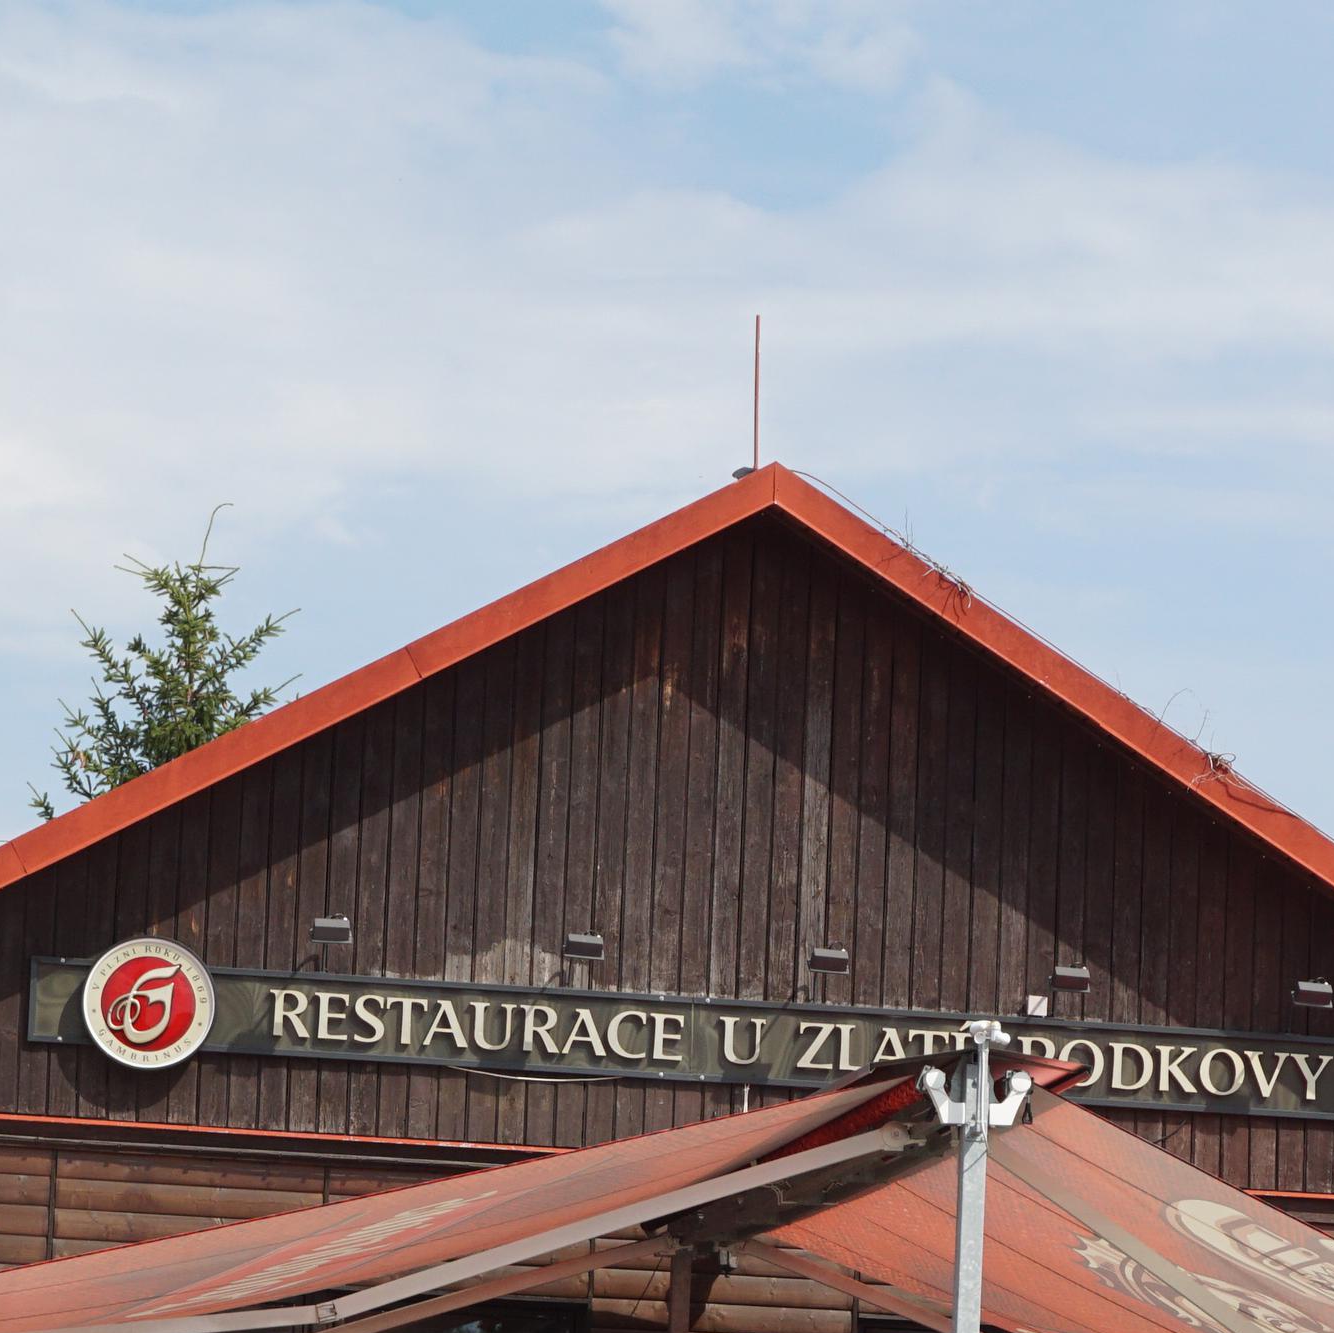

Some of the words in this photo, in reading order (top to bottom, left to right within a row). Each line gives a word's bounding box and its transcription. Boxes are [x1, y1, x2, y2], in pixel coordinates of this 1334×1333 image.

[98, 1028, 192, 1063] GAMBRINUS
[269, 988, 685, 1061] RESTAURACE
[719, 1016, 766, 1065] U
